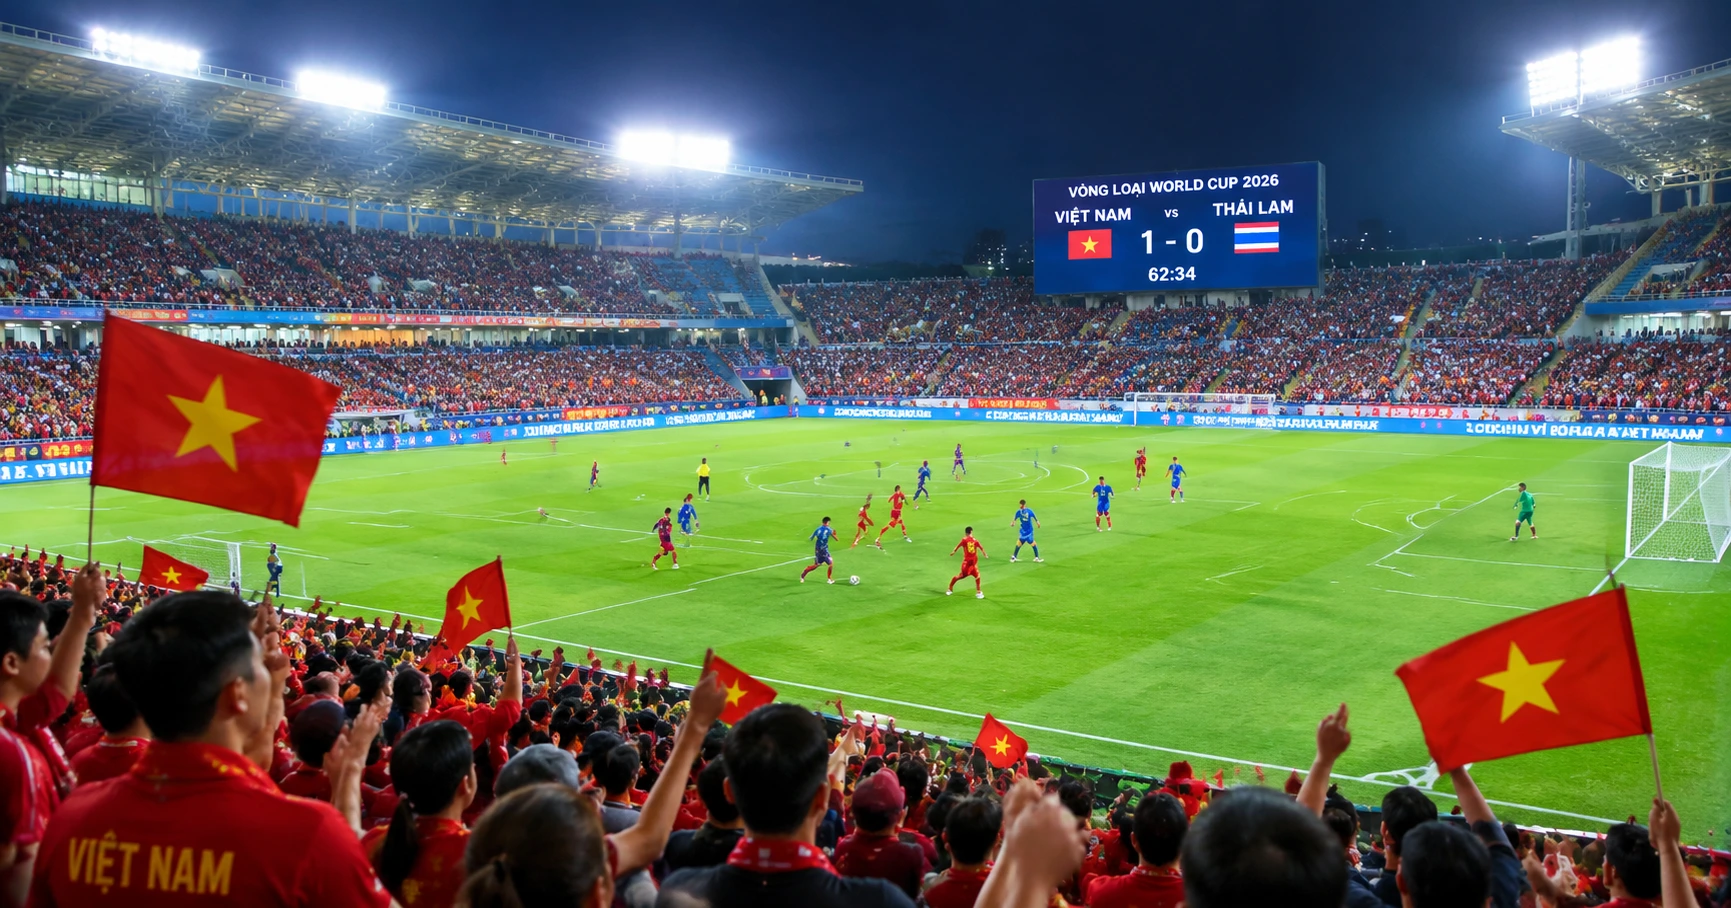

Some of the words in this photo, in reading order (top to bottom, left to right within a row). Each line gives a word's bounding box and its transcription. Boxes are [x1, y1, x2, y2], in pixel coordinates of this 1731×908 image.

[1112, 181, 1146, 198] LOẠI
[1149, 178, 1204, 194] WORLD
[1207, 176, 1239, 190] CUP
[1242, 173, 1280, 189] 2026
[1054, 206, 1091, 226] VIỆT
[1094, 207, 1132, 222] NAM
[1258, 199, 1294, 215] LAM
[1141, 229, 1153, 255] 1
[1186, 228, 1204, 254] 0
[1148, 266, 1197, 282] 62:34
[69, 830, 140, 894] VIỆT
[147, 845, 234, 895] NAM
